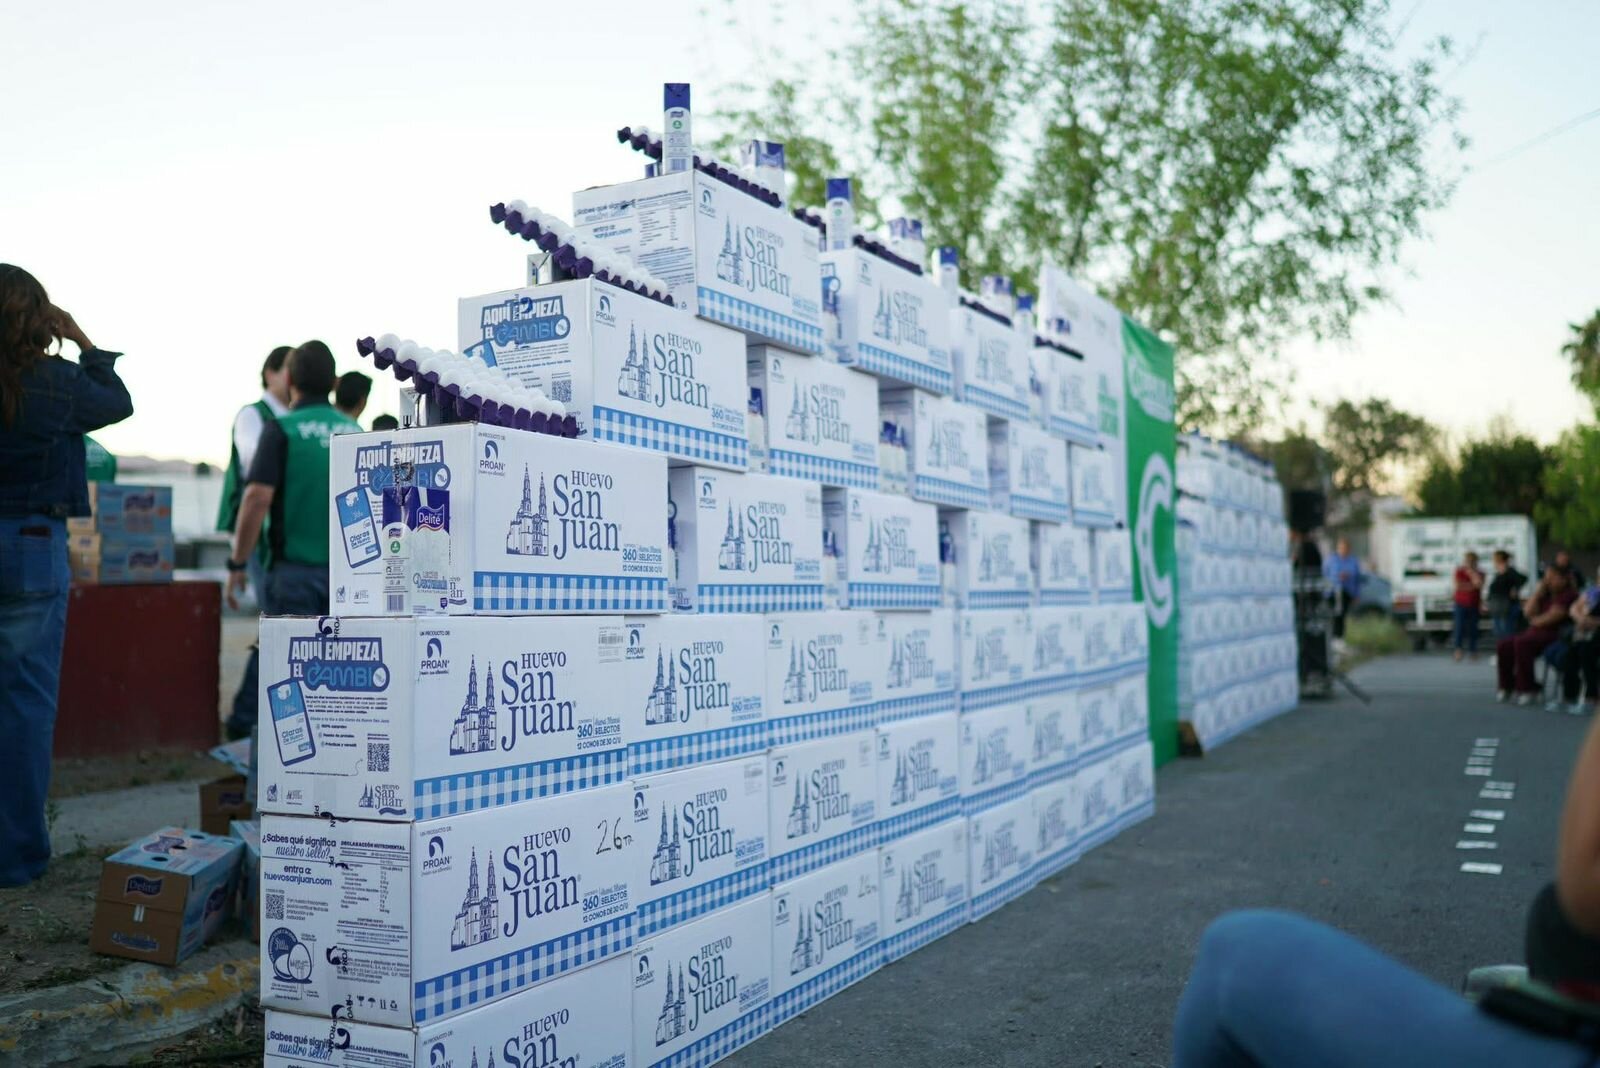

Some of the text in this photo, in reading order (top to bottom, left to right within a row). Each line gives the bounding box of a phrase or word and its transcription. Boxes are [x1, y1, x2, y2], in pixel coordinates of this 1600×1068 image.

[745, 226, 778, 269] San
[748, 260, 790, 298] Juan
[485, 326, 494, 339] EL
[653, 333, 694, 379] San
[655, 371, 709, 409] Juan
[810, 385, 840, 420] San
[811, 416, 850, 446] Juan
[360, 471, 369, 485] EL
[480, 460, 504, 471] PROAN
[552, 473, 603, 520] San
[418, 512, 441, 525] Delité
[747, 505, 781, 540] San
[553, 518, 620, 560] Juan
[622, 548, 637, 561] 360
[749, 539, 793, 573] Juan
[325, 641, 380, 661] EMPIEZA
[421, 660, 447, 669] PROAN
[679, 648, 716, 685] San
[807, 640, 837, 670] San
[293, 663, 304, 677] EL
[501, 660, 556, 705] San
[809, 668, 848, 703] Juan
[680, 682, 730, 723] Juan
[501, 700, 575, 751] Juan
[577, 723, 593, 738] 360
[375, 785, 395, 798] San
[811, 769, 840, 800] San
[683, 801, 720, 839] San
[812, 793, 850, 833] Juan
[262, 833, 337, 848] ¿Sabes qué significa
[276, 845, 331, 860] nuestro sello?
[684, 829, 733, 877] Juan
[264, 872, 333, 886] huevosanjuan.com
[284, 865, 304, 874] entra
[423, 856, 450, 870] PROAN
[502, 844, 561, 891] San
[503, 875, 579, 938] Juan
[583, 894, 599, 911] 360
[601, 890, 628, 905] SELECTOS
[814, 900, 843, 932] San
[815, 919, 853, 964] Juan
[688, 954, 725, 994] San
[689, 975, 737, 1031] Juan
[294, 1036, 308, 1047] qué
[503, 1033, 558, 1068] San
